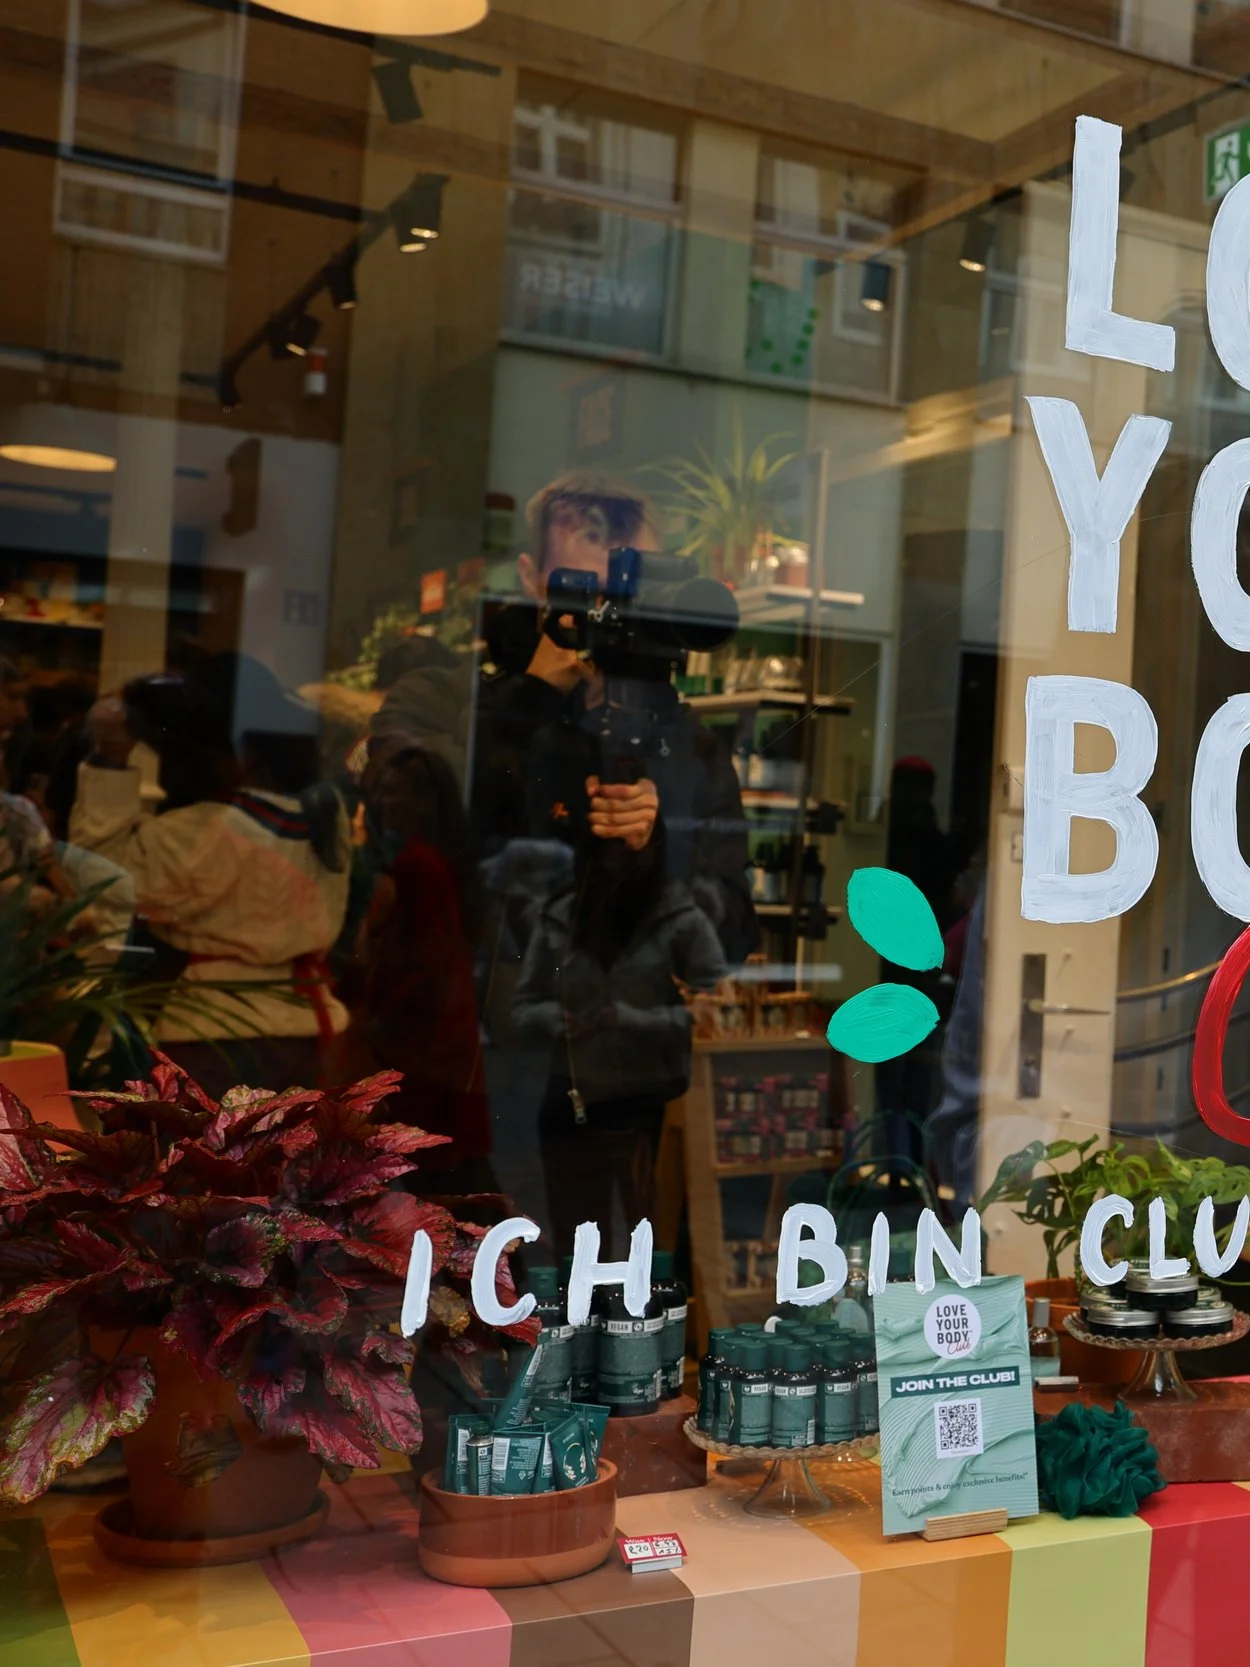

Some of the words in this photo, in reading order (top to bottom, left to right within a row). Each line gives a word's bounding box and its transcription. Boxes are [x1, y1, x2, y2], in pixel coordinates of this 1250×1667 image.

[401, 1217, 653, 1338] ICH
[776, 1202, 982, 1306] BIN
[936, 1304, 967, 1318] LOVE
[609, 1323, 629, 1331] VEGAN
[936, 1317, 969, 1331] YOUR
[947, 1338, 972, 1355] Club
[895, 1378, 935, 1393] JOIN
[936, 1375, 968, 1389] THE
[969, 1370, 1016, 1385] CLUB!
[892, 1487, 910, 1497] Earn
[910, 1484, 935, 1496] points
[935, 1483, 942, 1491] &
[942, 1481, 961, 1492] enjoy
[962, 1477, 994, 1488] exclusive
